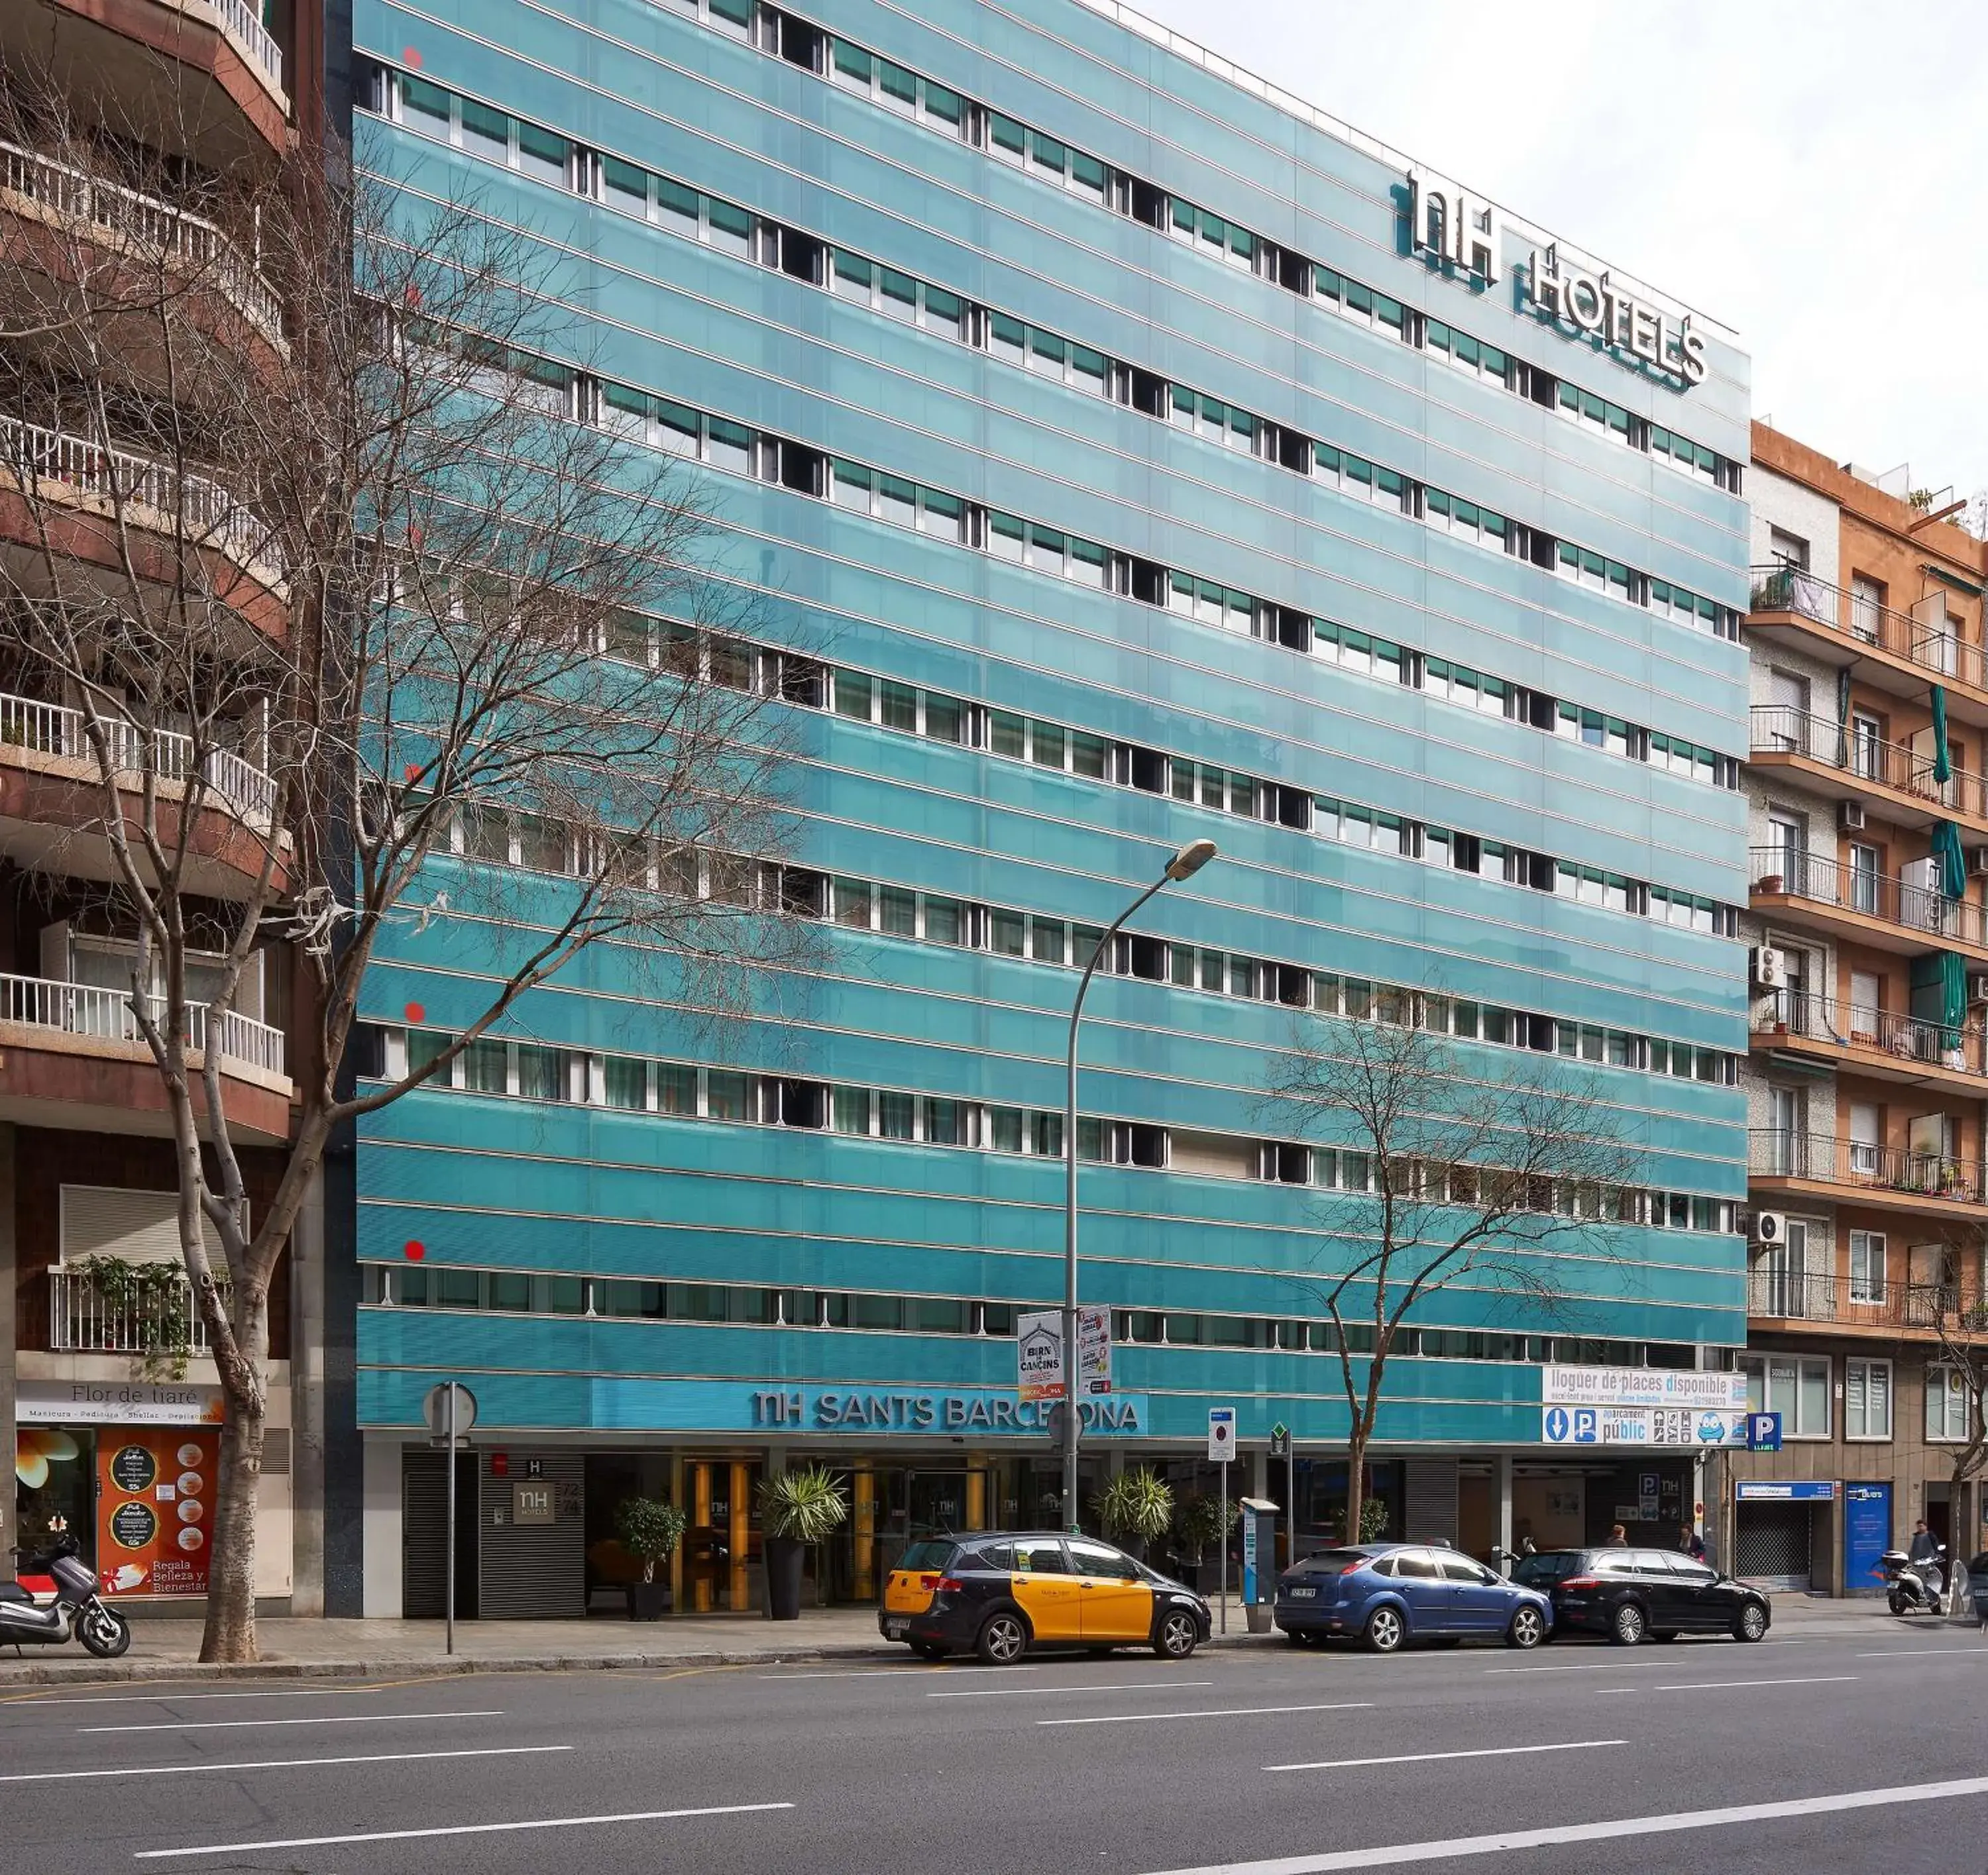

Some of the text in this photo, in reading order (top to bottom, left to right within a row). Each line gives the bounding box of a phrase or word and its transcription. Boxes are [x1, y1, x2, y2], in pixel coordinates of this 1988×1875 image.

[1529, 242, 1708, 386] HOTELS
[1552, 1369, 1727, 1396] lloguer de places disponible
[71, 1385, 197, 1404] Flor de tiaré
[818, 1393, 935, 1425] SANTS
[946, 1397, 1138, 1429] BARCEONA
[1604, 1419, 1645, 1443] públic
[1755, 1416, 1774, 1442] P
[530, 1460, 540, 1473] H
[153, 1560, 191, 1571] Regala
[153, 1570, 204, 1581] Belleza y
[153, 1582, 207, 1593] Bienestar
